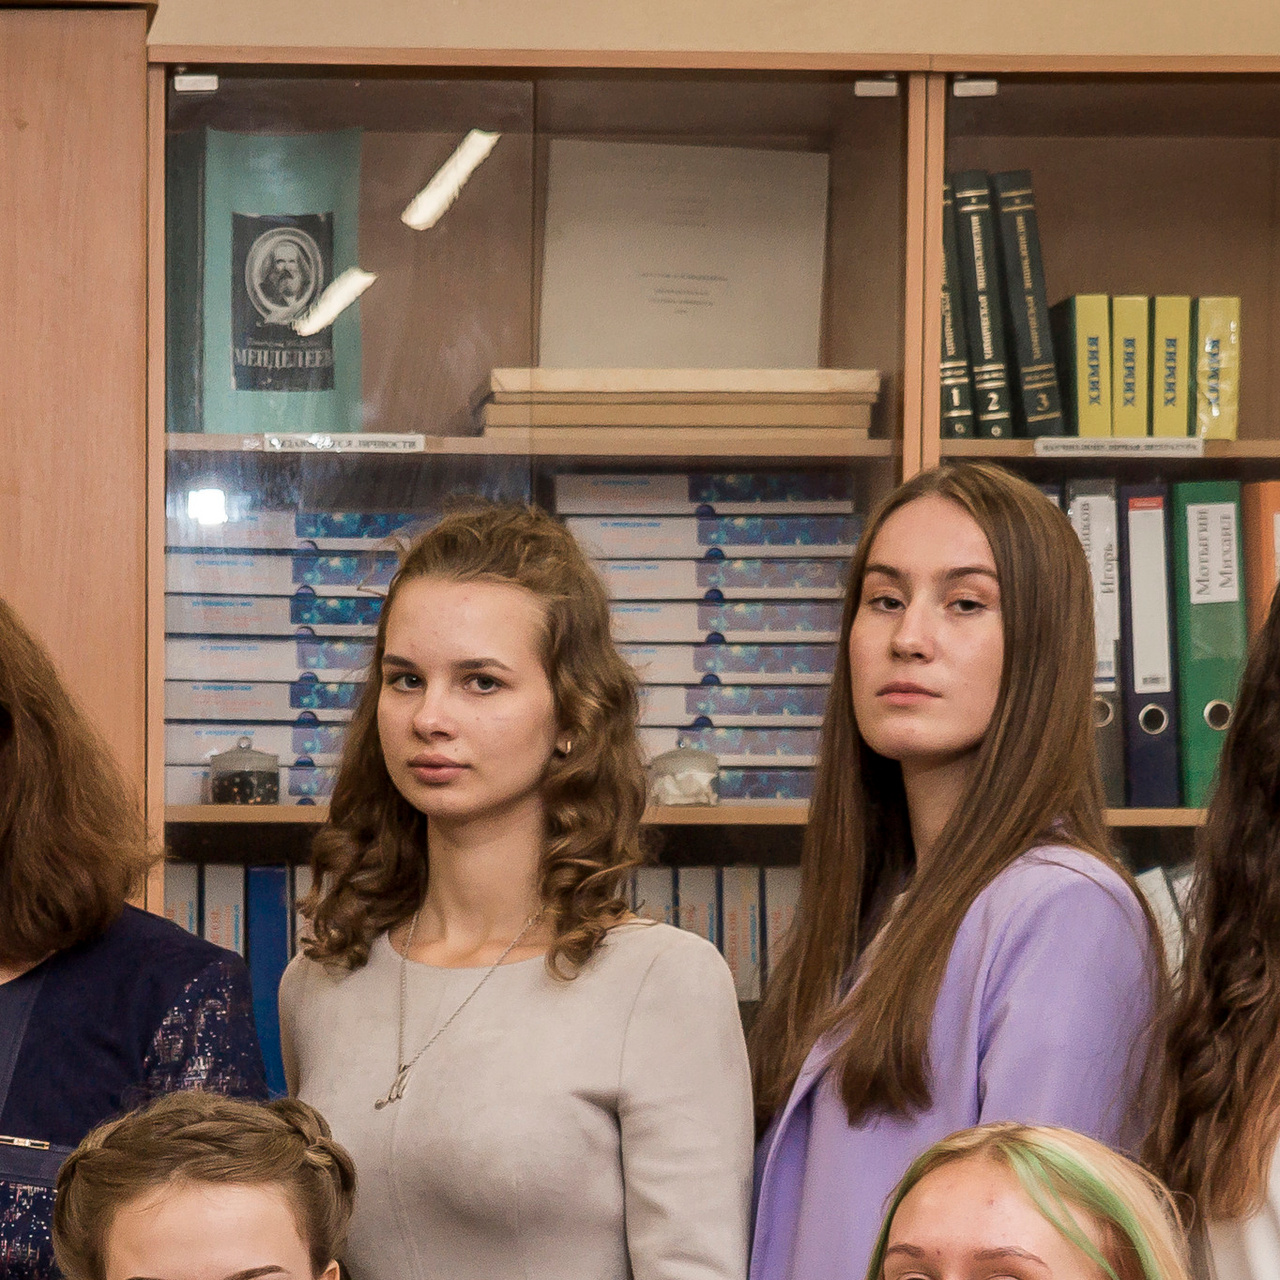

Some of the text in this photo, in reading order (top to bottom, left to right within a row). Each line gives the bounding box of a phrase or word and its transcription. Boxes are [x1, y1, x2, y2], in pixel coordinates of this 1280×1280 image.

[1087, 336, 1102, 406] ХИМИЯ
[1123, 337, 1136, 407] ХИМИЯ
[1163, 337, 1178, 407] ХИМИЯ
[951, 387, 961, 407] 1
[987, 391, 1001, 411] 2
[1036, 393, 1050, 411] 3
